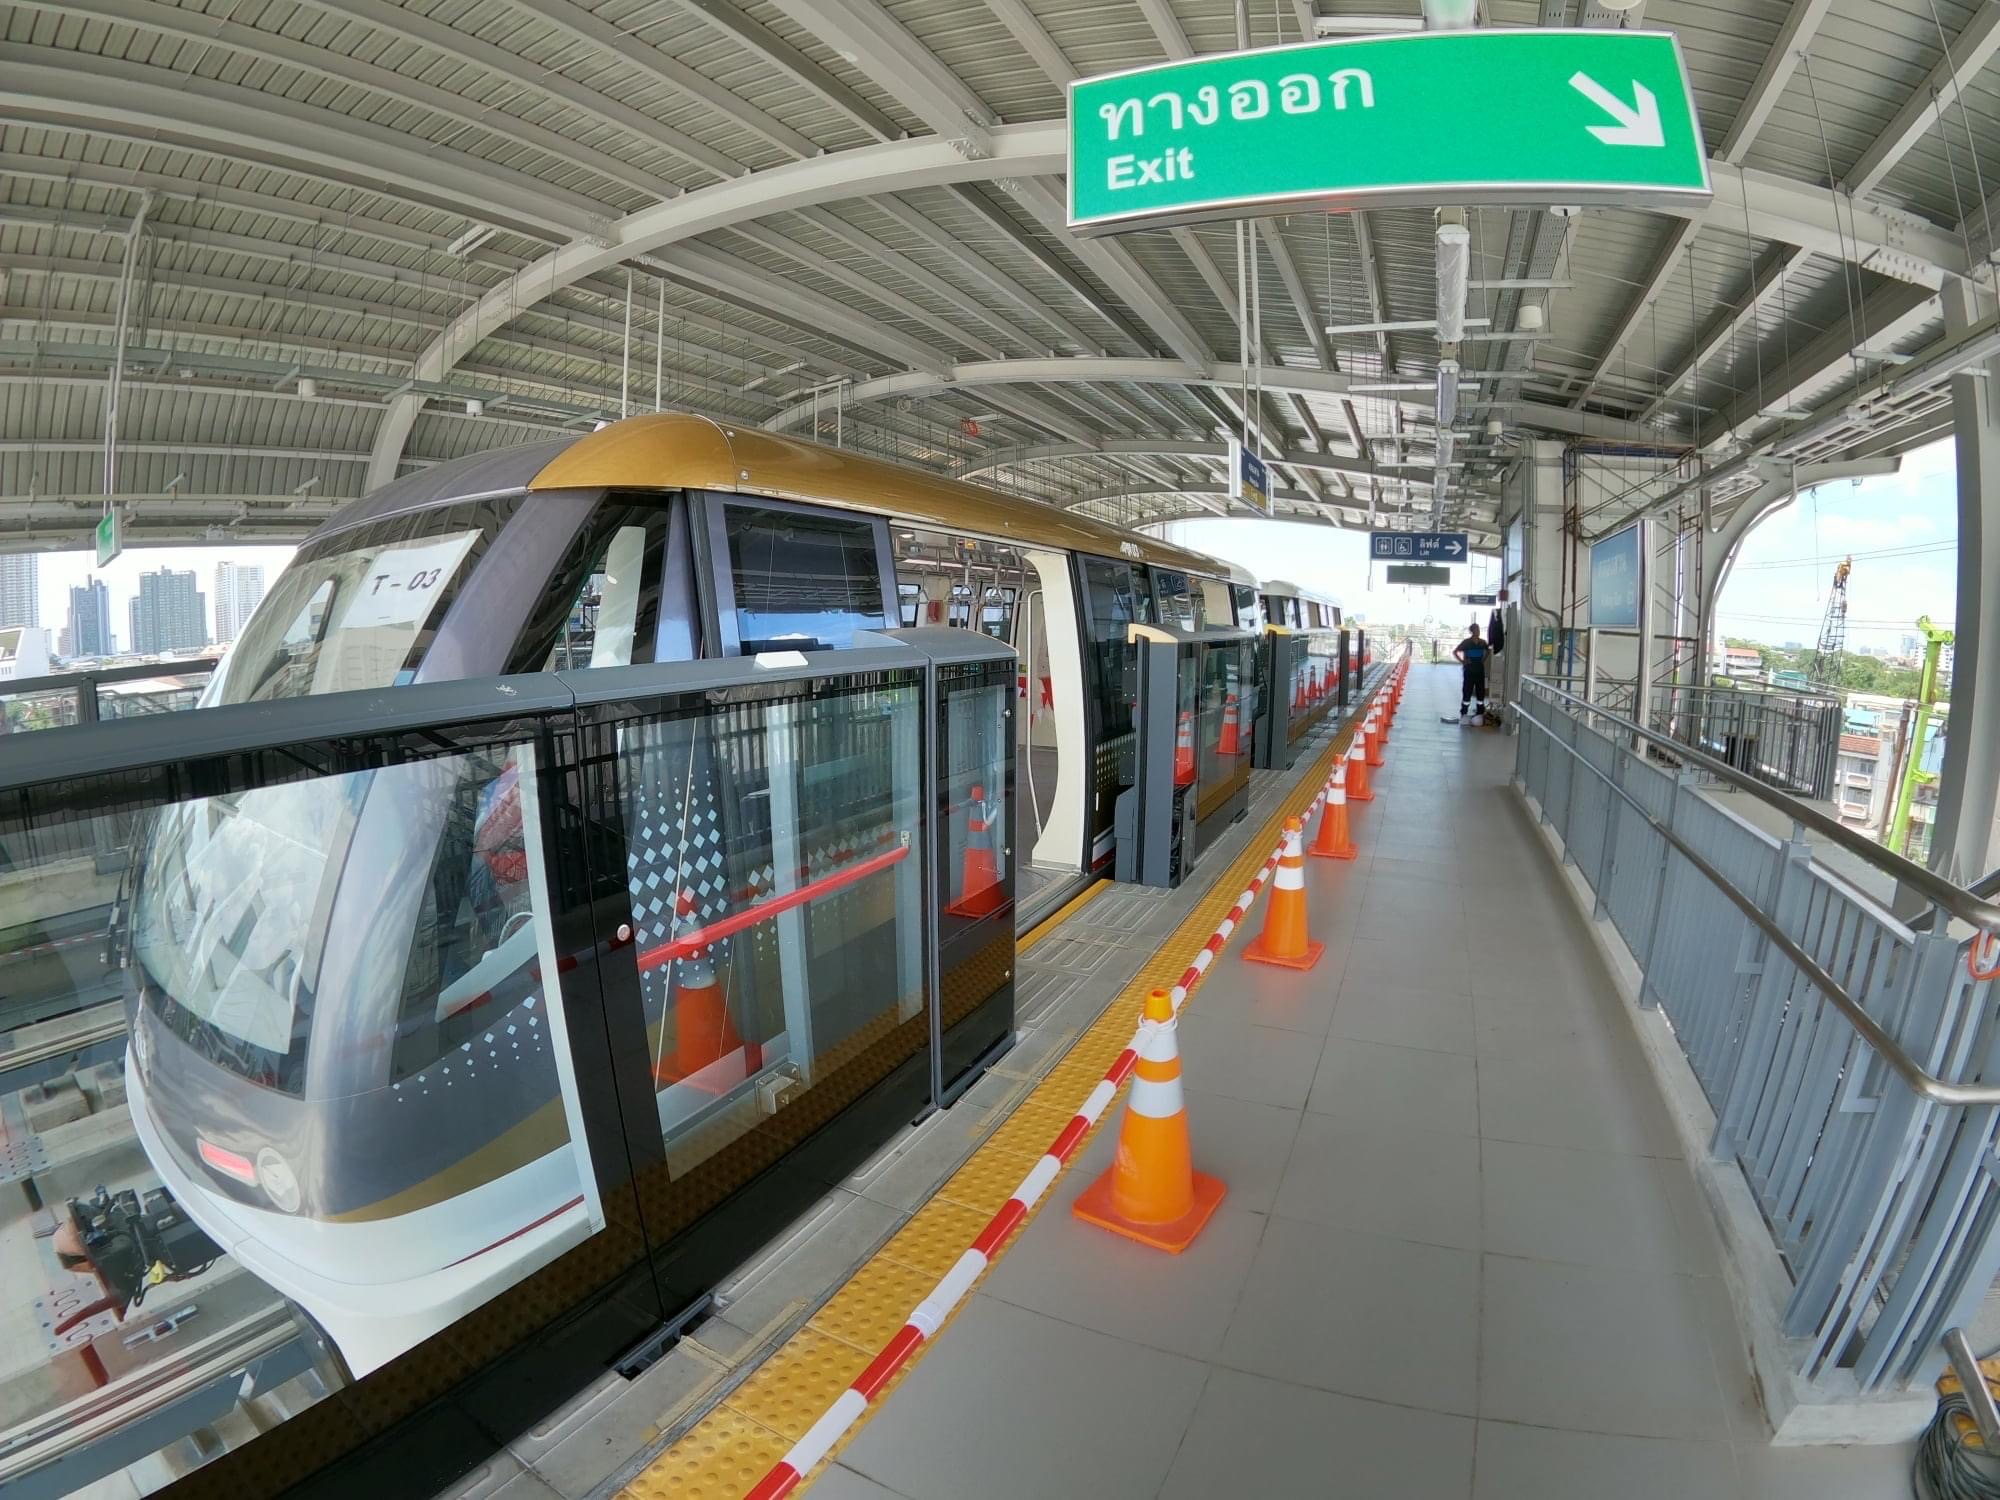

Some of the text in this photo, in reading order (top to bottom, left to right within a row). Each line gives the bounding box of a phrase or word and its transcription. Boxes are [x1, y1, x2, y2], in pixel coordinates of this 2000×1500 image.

[1099, 68, 1375, 141] ทางออก
[1107, 146, 1195, 190] Exit
